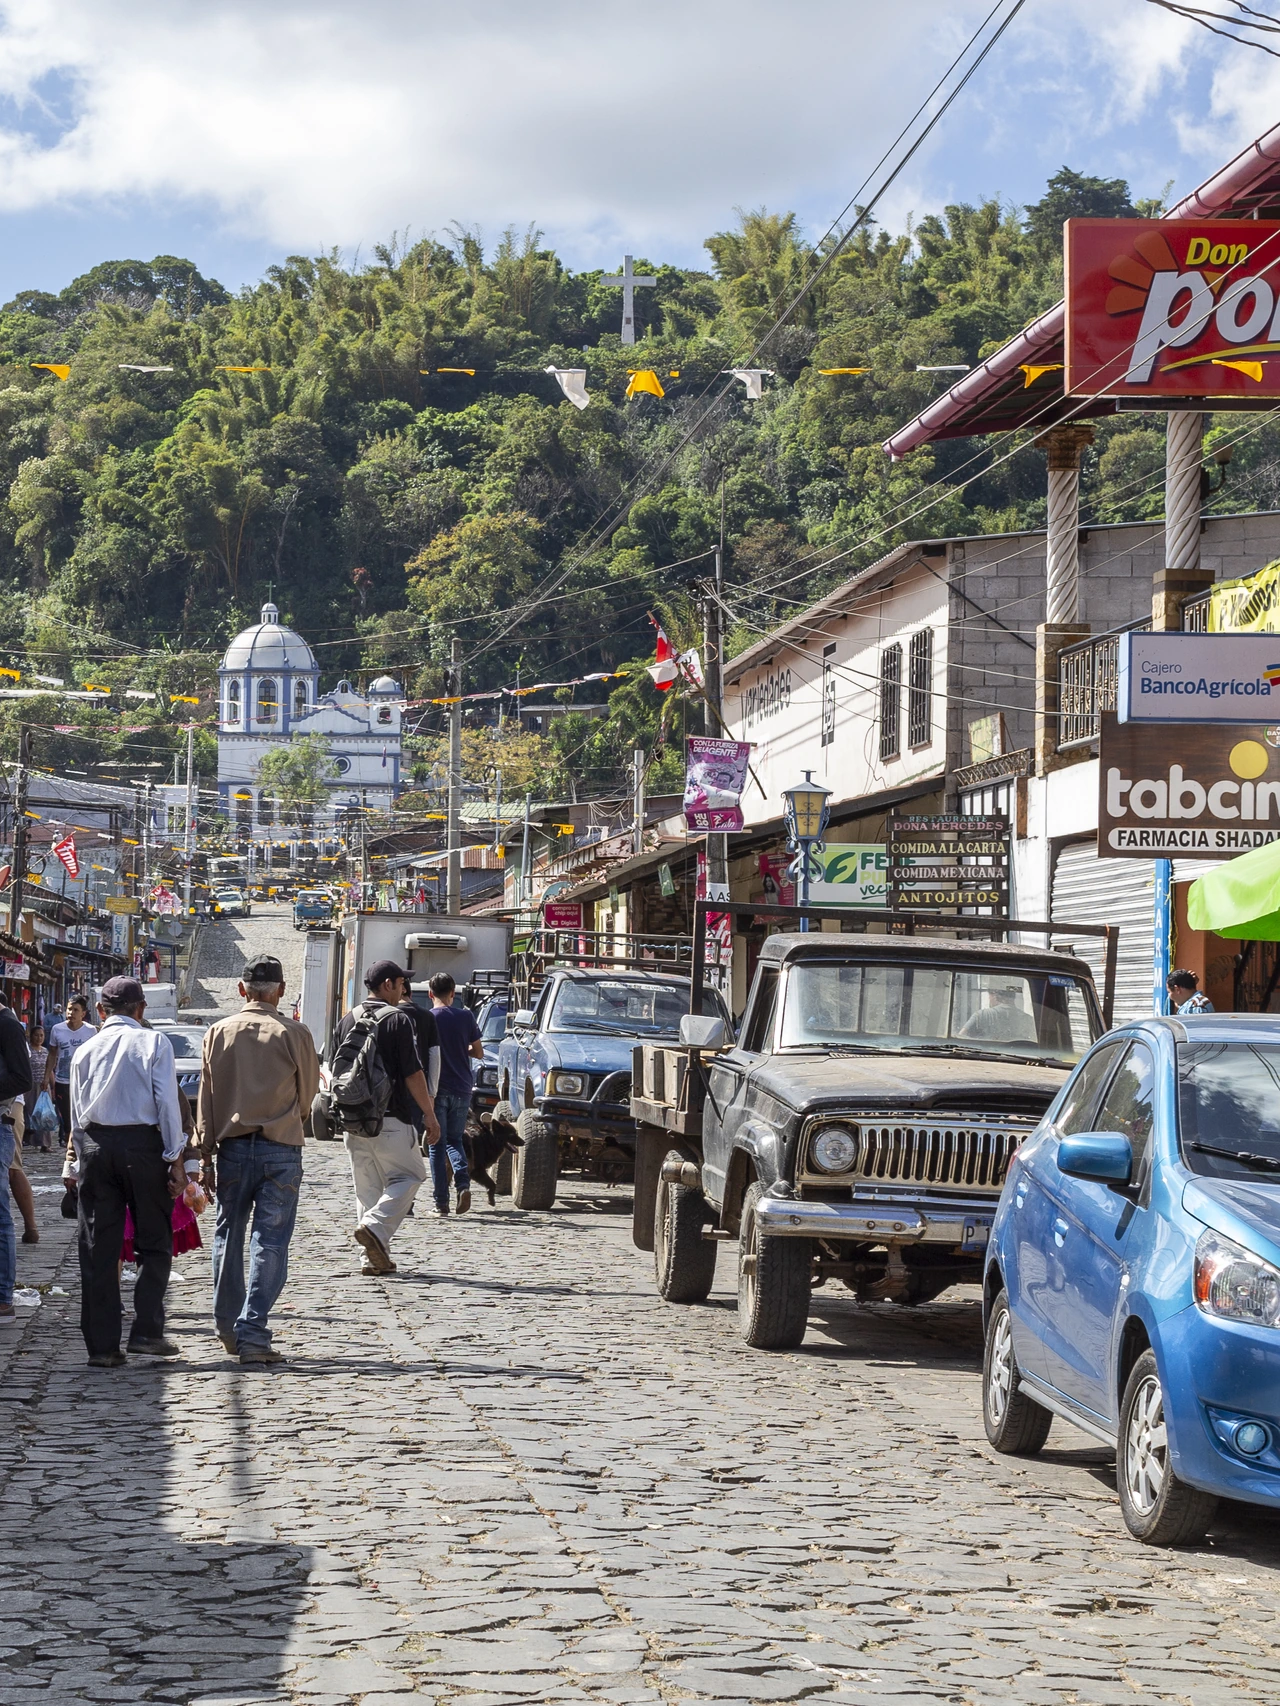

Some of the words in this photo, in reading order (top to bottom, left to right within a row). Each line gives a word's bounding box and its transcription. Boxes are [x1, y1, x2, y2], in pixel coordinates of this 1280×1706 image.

[1185, 237, 1248, 265] Don
[1141, 661, 1182, 676] Cajero
[1141, 677, 1271, 698] BancoAgrícola
[709, 748, 737, 757] GENTE
[909, 815, 988, 823] RESTAURANTE
[931, 821, 1004, 831] MERCEDES
[1117, 830, 1210, 847] FARMACIA
[891, 842, 937, 854] COMIDA
[938, 843, 947, 854] A
[949, 843, 966, 854] LA
[966, 841, 1006, 853] CARTA
[893, 868, 939, 879] COMIDA
[940, 867, 1005, 878] MEXICANA
[898, 891, 1000, 903] ANTOJITOS
[966, 1225, 975, 1244] P
